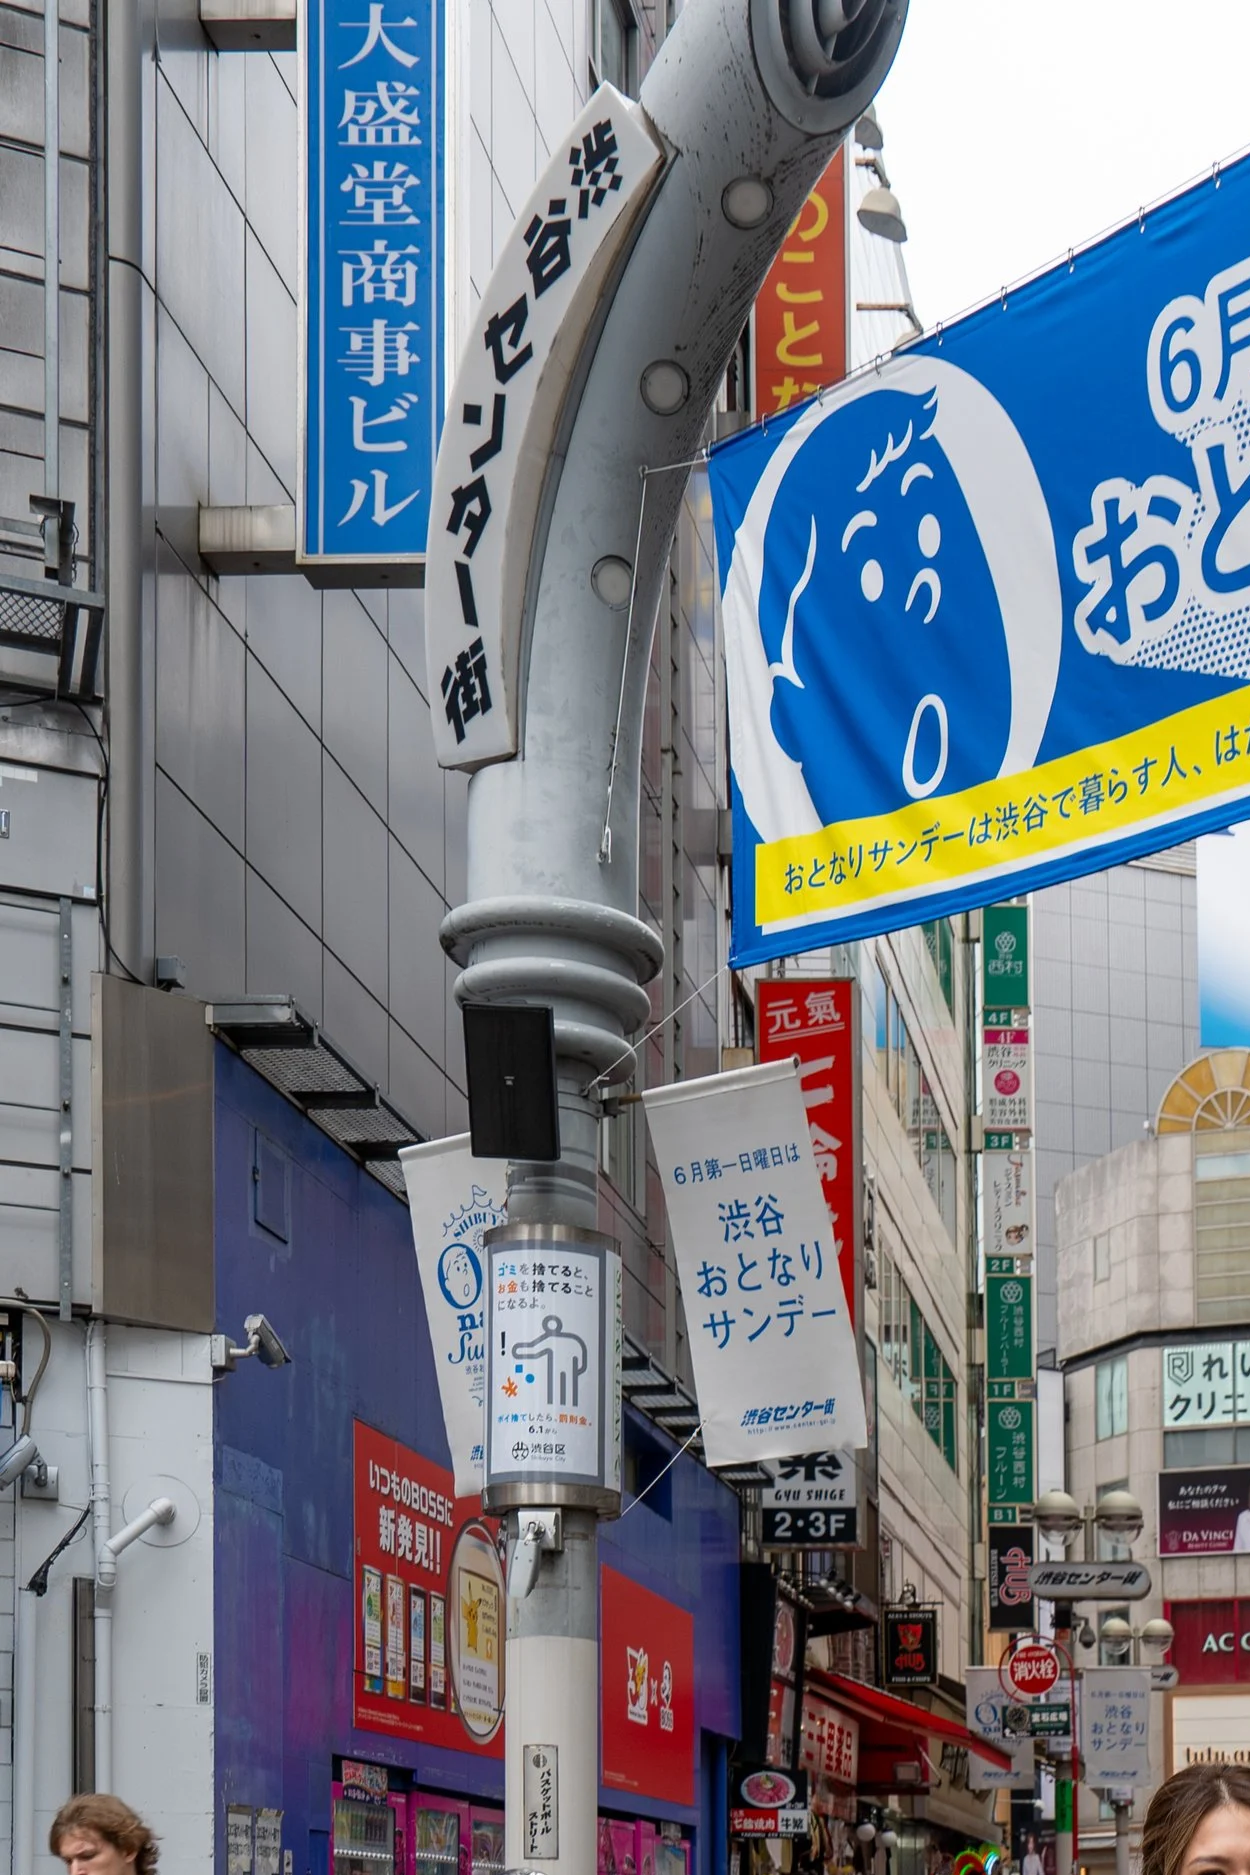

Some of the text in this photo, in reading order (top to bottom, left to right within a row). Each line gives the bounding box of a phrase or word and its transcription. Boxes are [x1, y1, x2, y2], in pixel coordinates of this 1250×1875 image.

[337, 3, 421, 528] 大盛堂商事ビル
[440, 118, 623, 744] 渋谷センター街
[766, 990, 841, 1034] 元氣
[988, 1013, 1008, 1024] 4F
[997, 1032, 1016, 1044] 4F
[990, 1134, 1009, 1147] 3F
[673, 1142, 800, 1185] 6月第一日曜日は
[718, 1193, 784, 1243] 渋谷
[498, 1262, 588, 1281] ゴミを捨てると、
[697, 1240, 823, 1298] おとなり
[991, 1259, 1010, 1271] 2F
[498, 1279, 594, 1298] お金も捨てること
[703, 1294, 836, 1350] サンデー
[993, 1385, 1011, 1397] 1F
[740, 1398, 836, 1427] 渋谷センター街
[531, 1443, 566, 1455] 渋谷区
[369, 1459, 454, 1527] いつものBOSSに
[774, 1489, 846, 1501] GYU SHIGE
[993, 1510, 1012, 1521] B1
[1201, 1529, 1233, 1540] VINCI
[1035, 1571, 1143, 1585] 渋谷センター街
[1013, 1659, 1055, 1681] 消火栓
[1105, 1704, 1133, 1719] 渋谷
[1091, 1722, 1145, 1735] おとなり
[1090, 1737, 1146, 1750] サンデー
[540, 1768, 552, 1836] バスケットボール
[529, 1811, 538, 1854] ストリート
